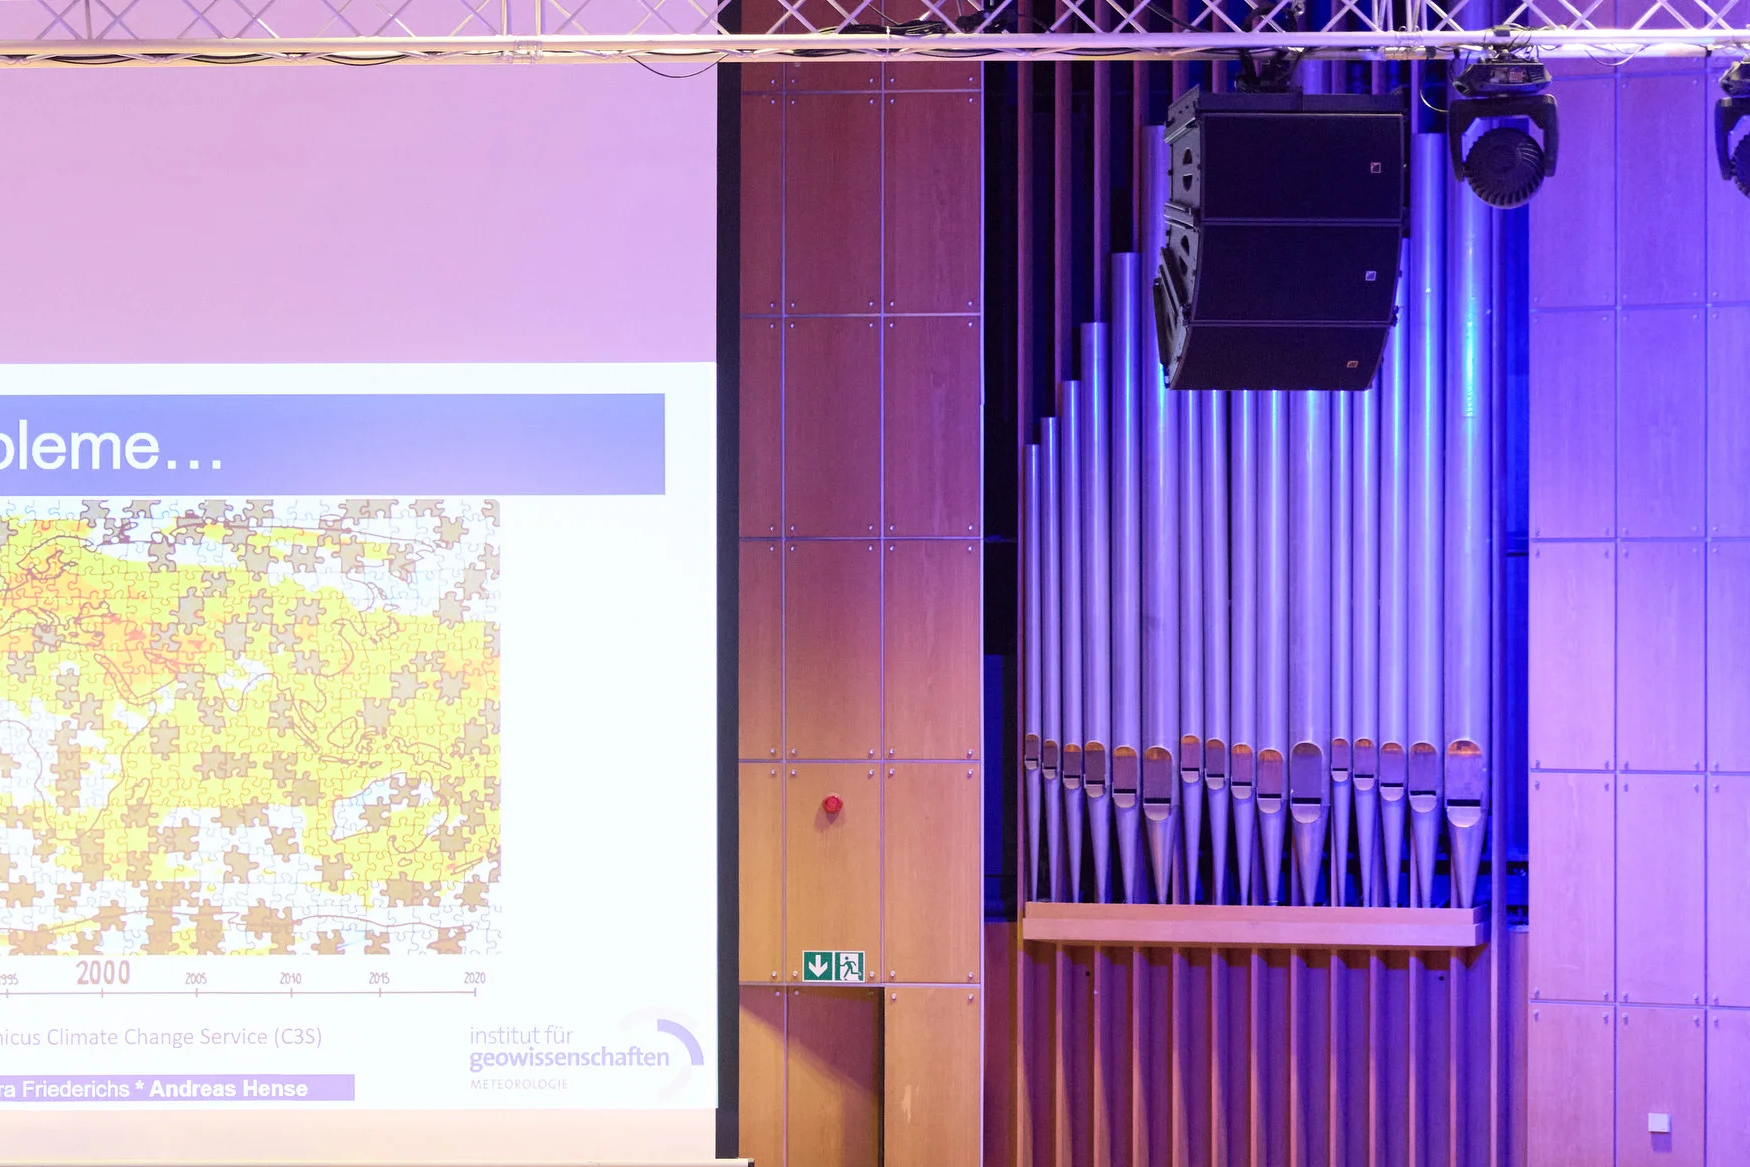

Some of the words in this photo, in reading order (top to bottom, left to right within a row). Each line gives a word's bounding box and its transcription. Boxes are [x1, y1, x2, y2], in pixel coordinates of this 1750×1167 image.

[75, 959, 131, 986] 2000
[185, 971, 208, 985] 2005
[279, 971, 302, 985] 2010
[368, 971, 391, 985] 2015
[463, 971, 486, 985] 2020
[46, 1028, 119, 1047] Climate
[124, 1028, 194, 1049] Change
[200, 1027, 268, 1046] Service
[274, 1026, 323, 1048] (C3S)
[470, 1026, 540, 1045] institut
[544, 1024, 575, 1045] für
[469, 1045, 670, 1073] geowissenschaften
[23, 1080, 130, 1098] Friederichs
[150, 1080, 237, 1098] Andreas
[243, 1080, 309, 1098] Hense
[470, 1078, 569, 1090] METEOROLOGIE
